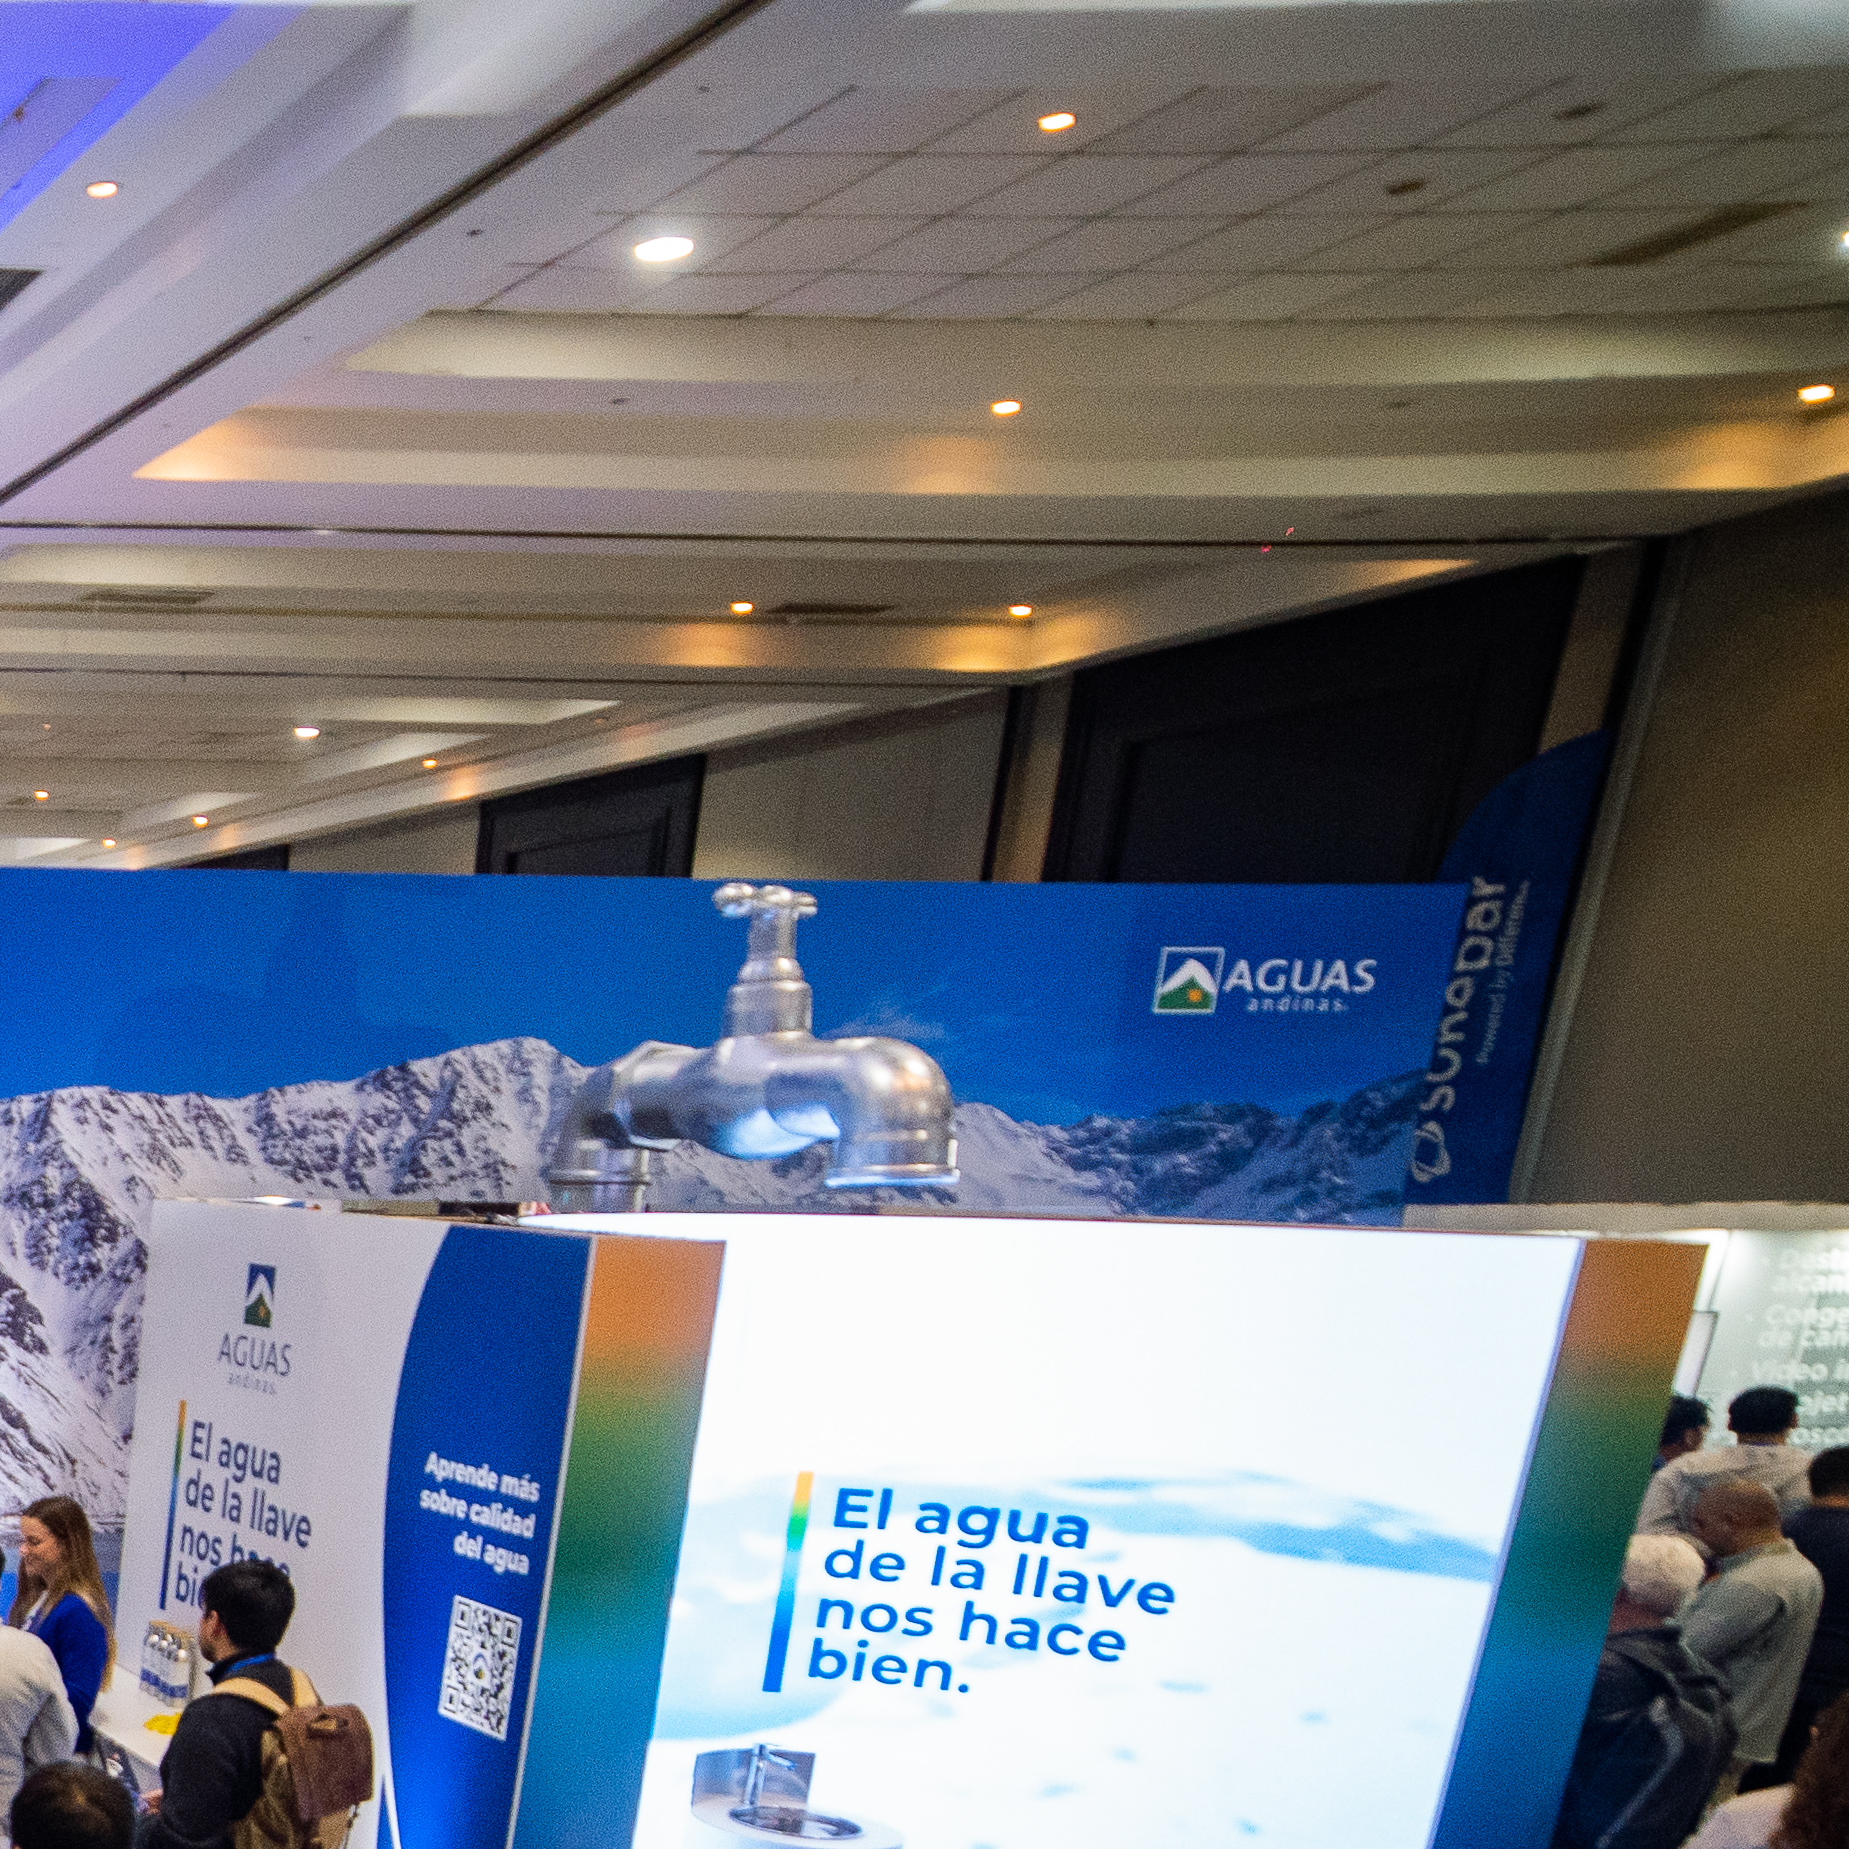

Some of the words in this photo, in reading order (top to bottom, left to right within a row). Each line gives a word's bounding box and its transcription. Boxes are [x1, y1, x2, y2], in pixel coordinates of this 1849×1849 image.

[1222, 958, 1378, 994] AGUAS
[217, 1332, 292, 1377] AGUAS
[190, 1418, 213, 1463] El
[218, 1437, 281, 1485] agua
[424, 1450, 499, 1492] Aprende
[499, 1473, 541, 1503] más
[185, 1468, 215, 1514] de
[221, 1477, 243, 1524] la
[250, 1486, 312, 1549] llave
[420, 1488, 468, 1520] sobre
[469, 1502, 537, 1540] calidad
[833, 1486, 894, 1531] El
[913, 1501, 1091, 1550] agua
[179, 1524, 223, 1567] nos
[453, 1530, 484, 1561] del
[483, 1544, 530, 1576] agua
[823, 1538, 907, 1583] de
[930, 1545, 986, 1591] la
[1012, 1553, 1177, 1616] llave
[815, 1597, 935, 1638] nos
[958, 1600, 1128, 1663] hace
[807, 1636, 970, 1695] bien.
